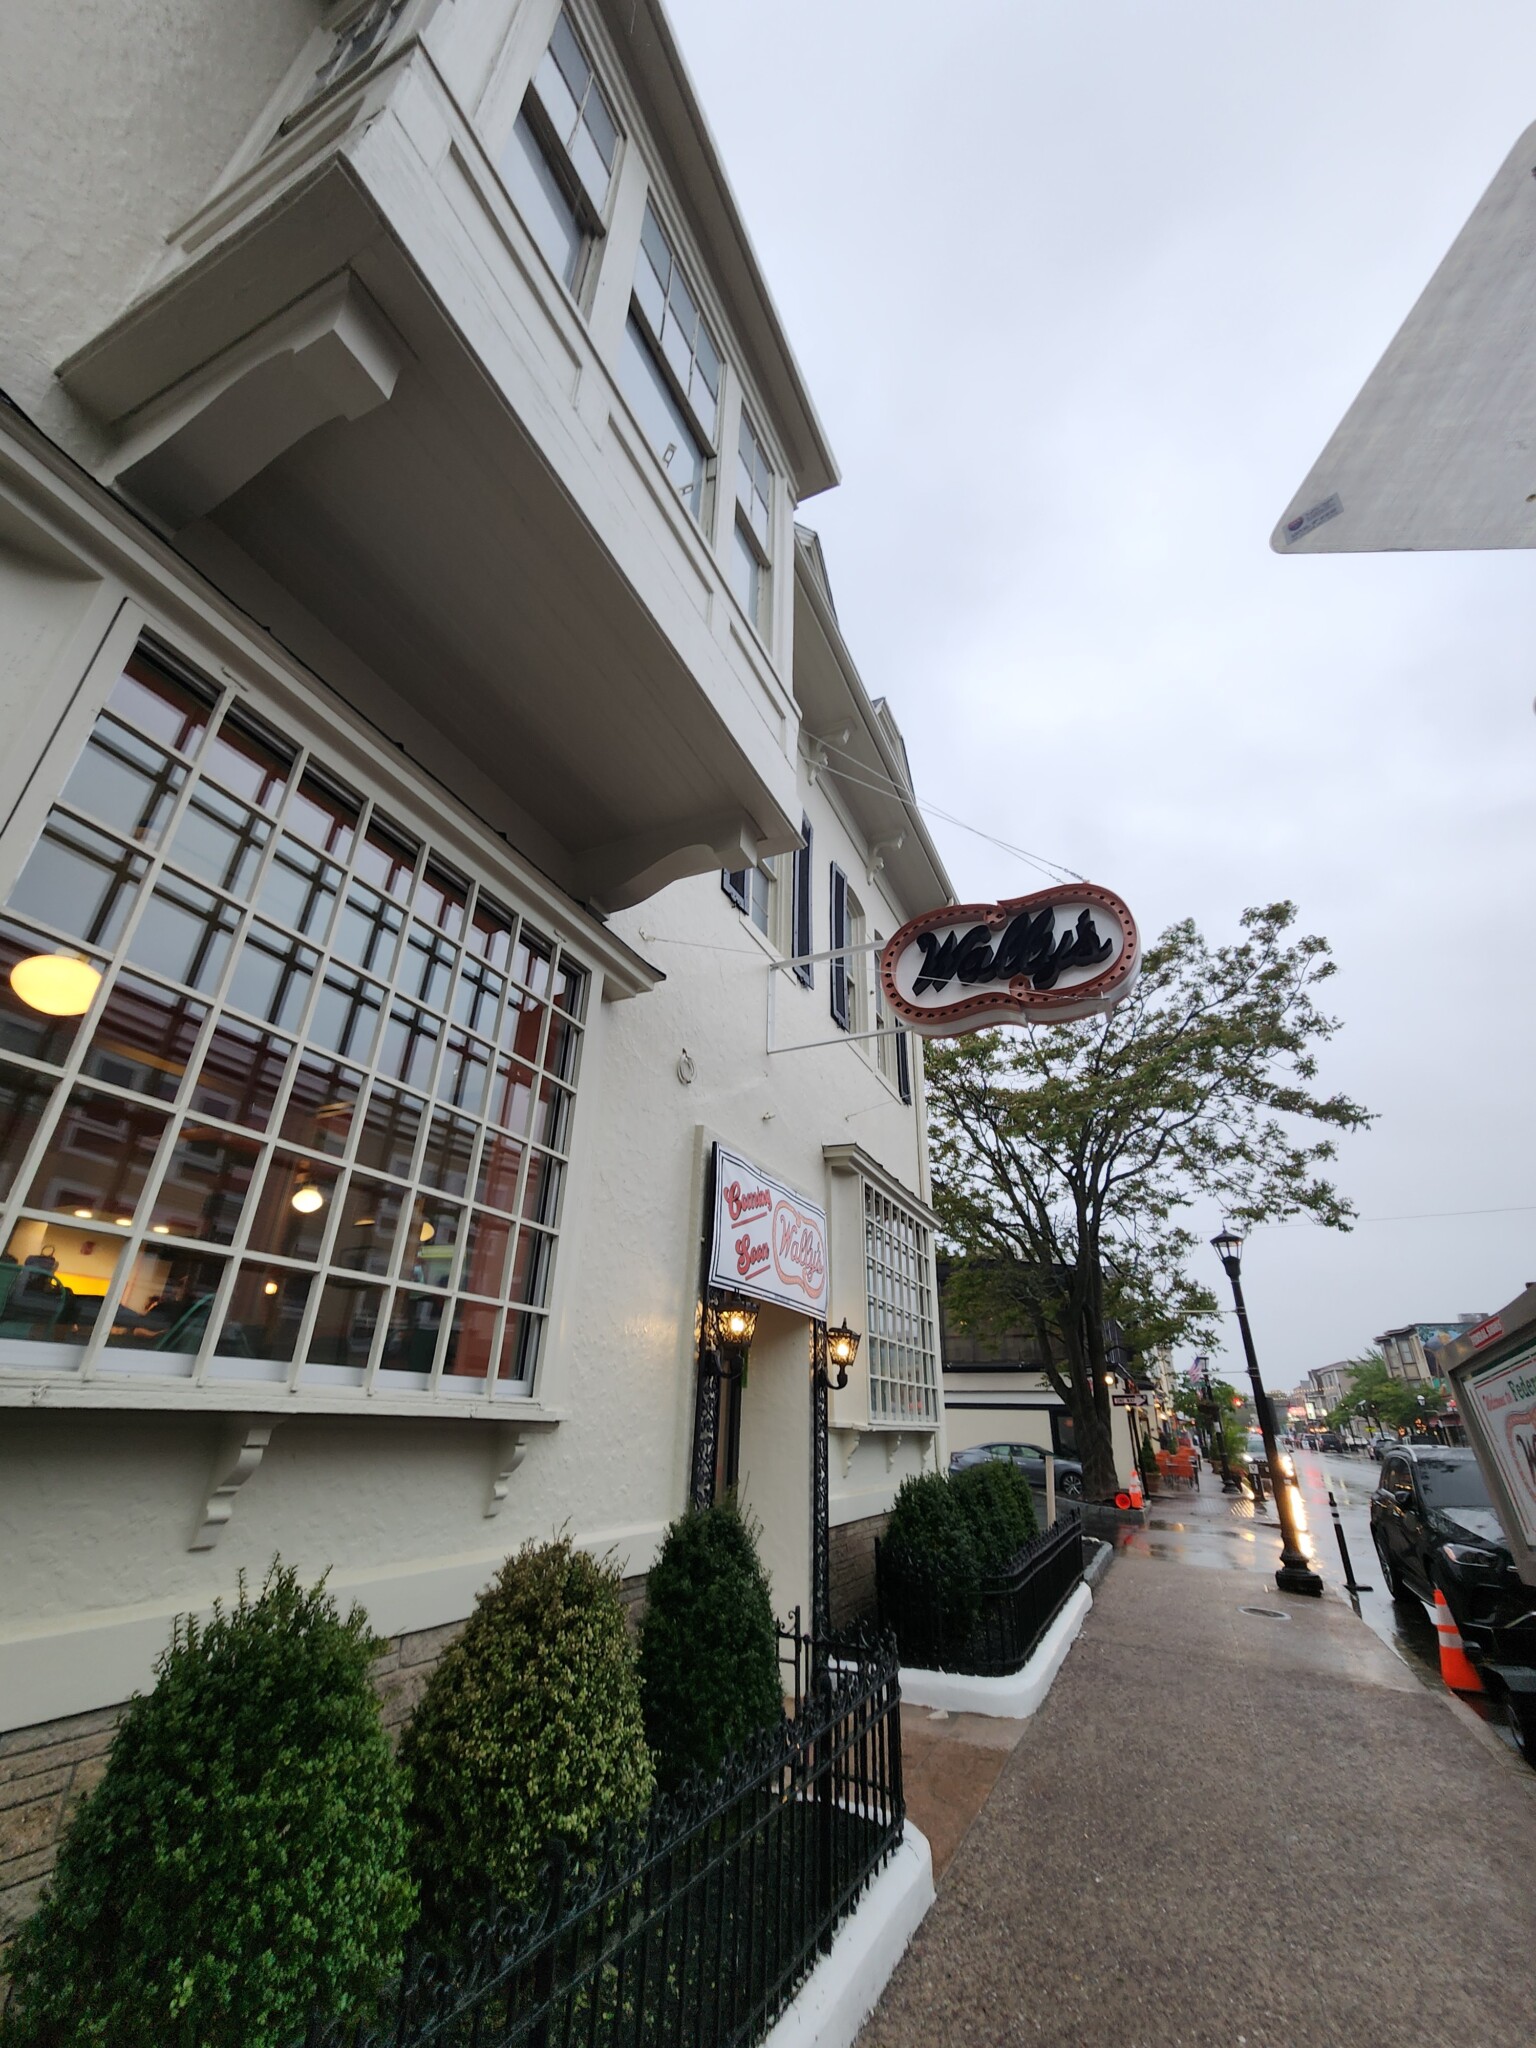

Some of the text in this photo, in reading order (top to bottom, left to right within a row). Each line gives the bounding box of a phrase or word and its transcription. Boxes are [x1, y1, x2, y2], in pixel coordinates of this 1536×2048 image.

[912, 906, 1113, 997] Wally's
[723, 1180, 773, 1221] Coming
[734, 1233, 770, 1276] Soon
[778, 1213, 824, 1283] Wally's
